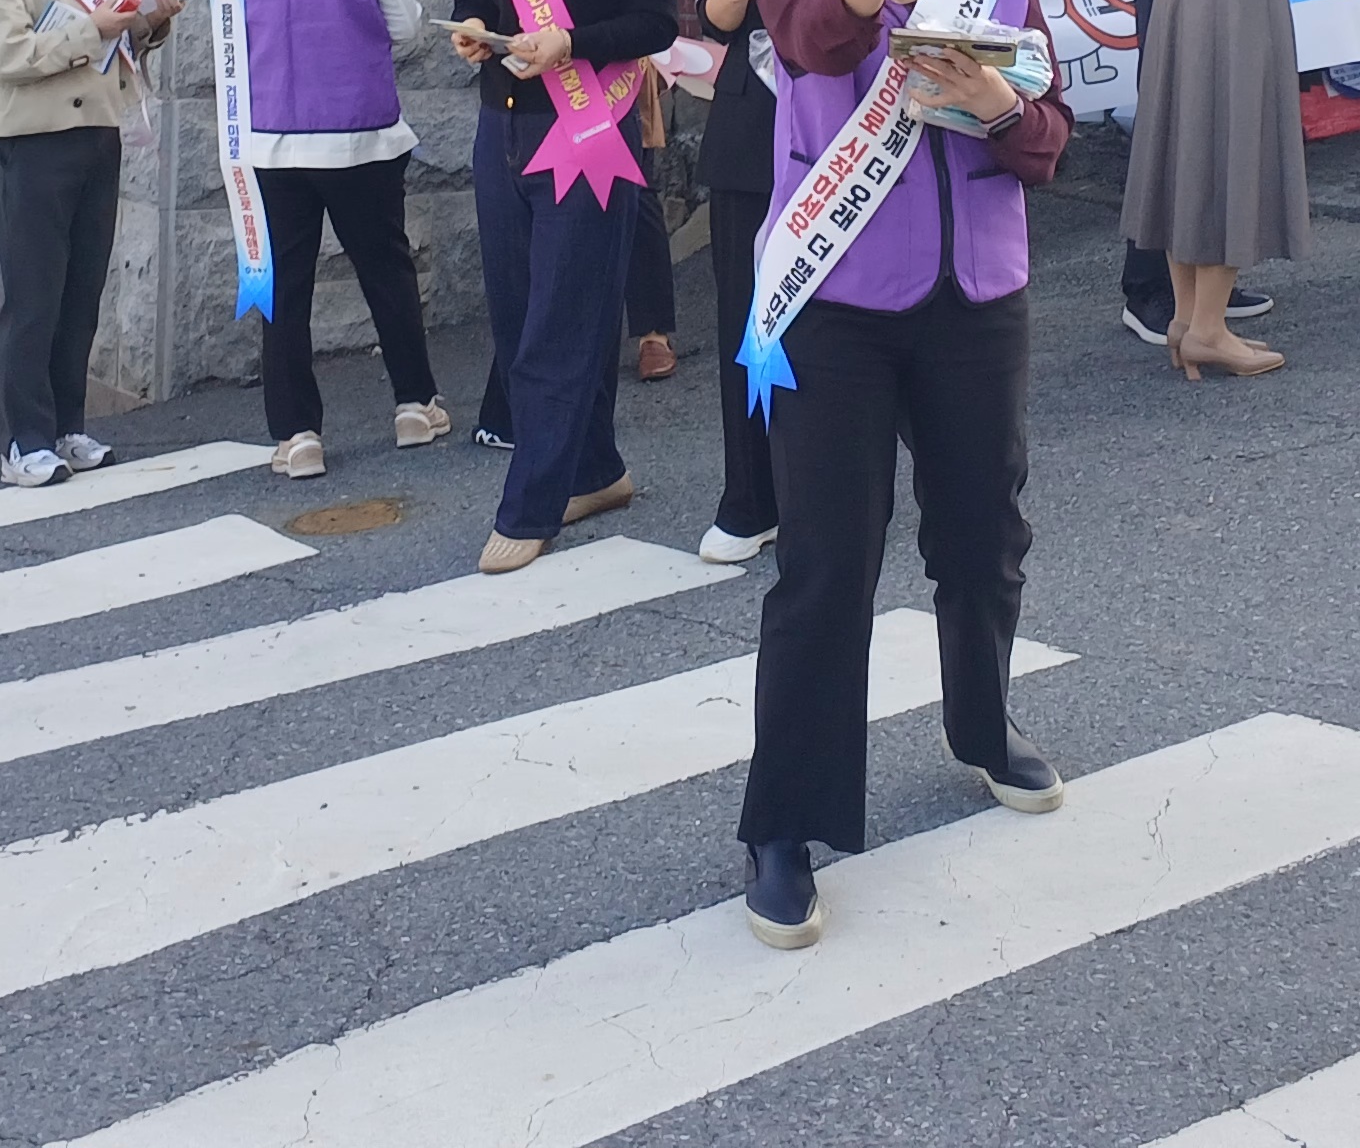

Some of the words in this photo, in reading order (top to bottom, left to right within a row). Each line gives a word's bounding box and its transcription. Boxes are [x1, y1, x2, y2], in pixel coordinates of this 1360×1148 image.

[785, 135, 871, 240] 시작하세요
[864, 156, 892, 186] 더
[829, 182, 872, 233] 오래
[806, 232, 835, 263] 더
[760, 254, 817, 339] 행복하게
